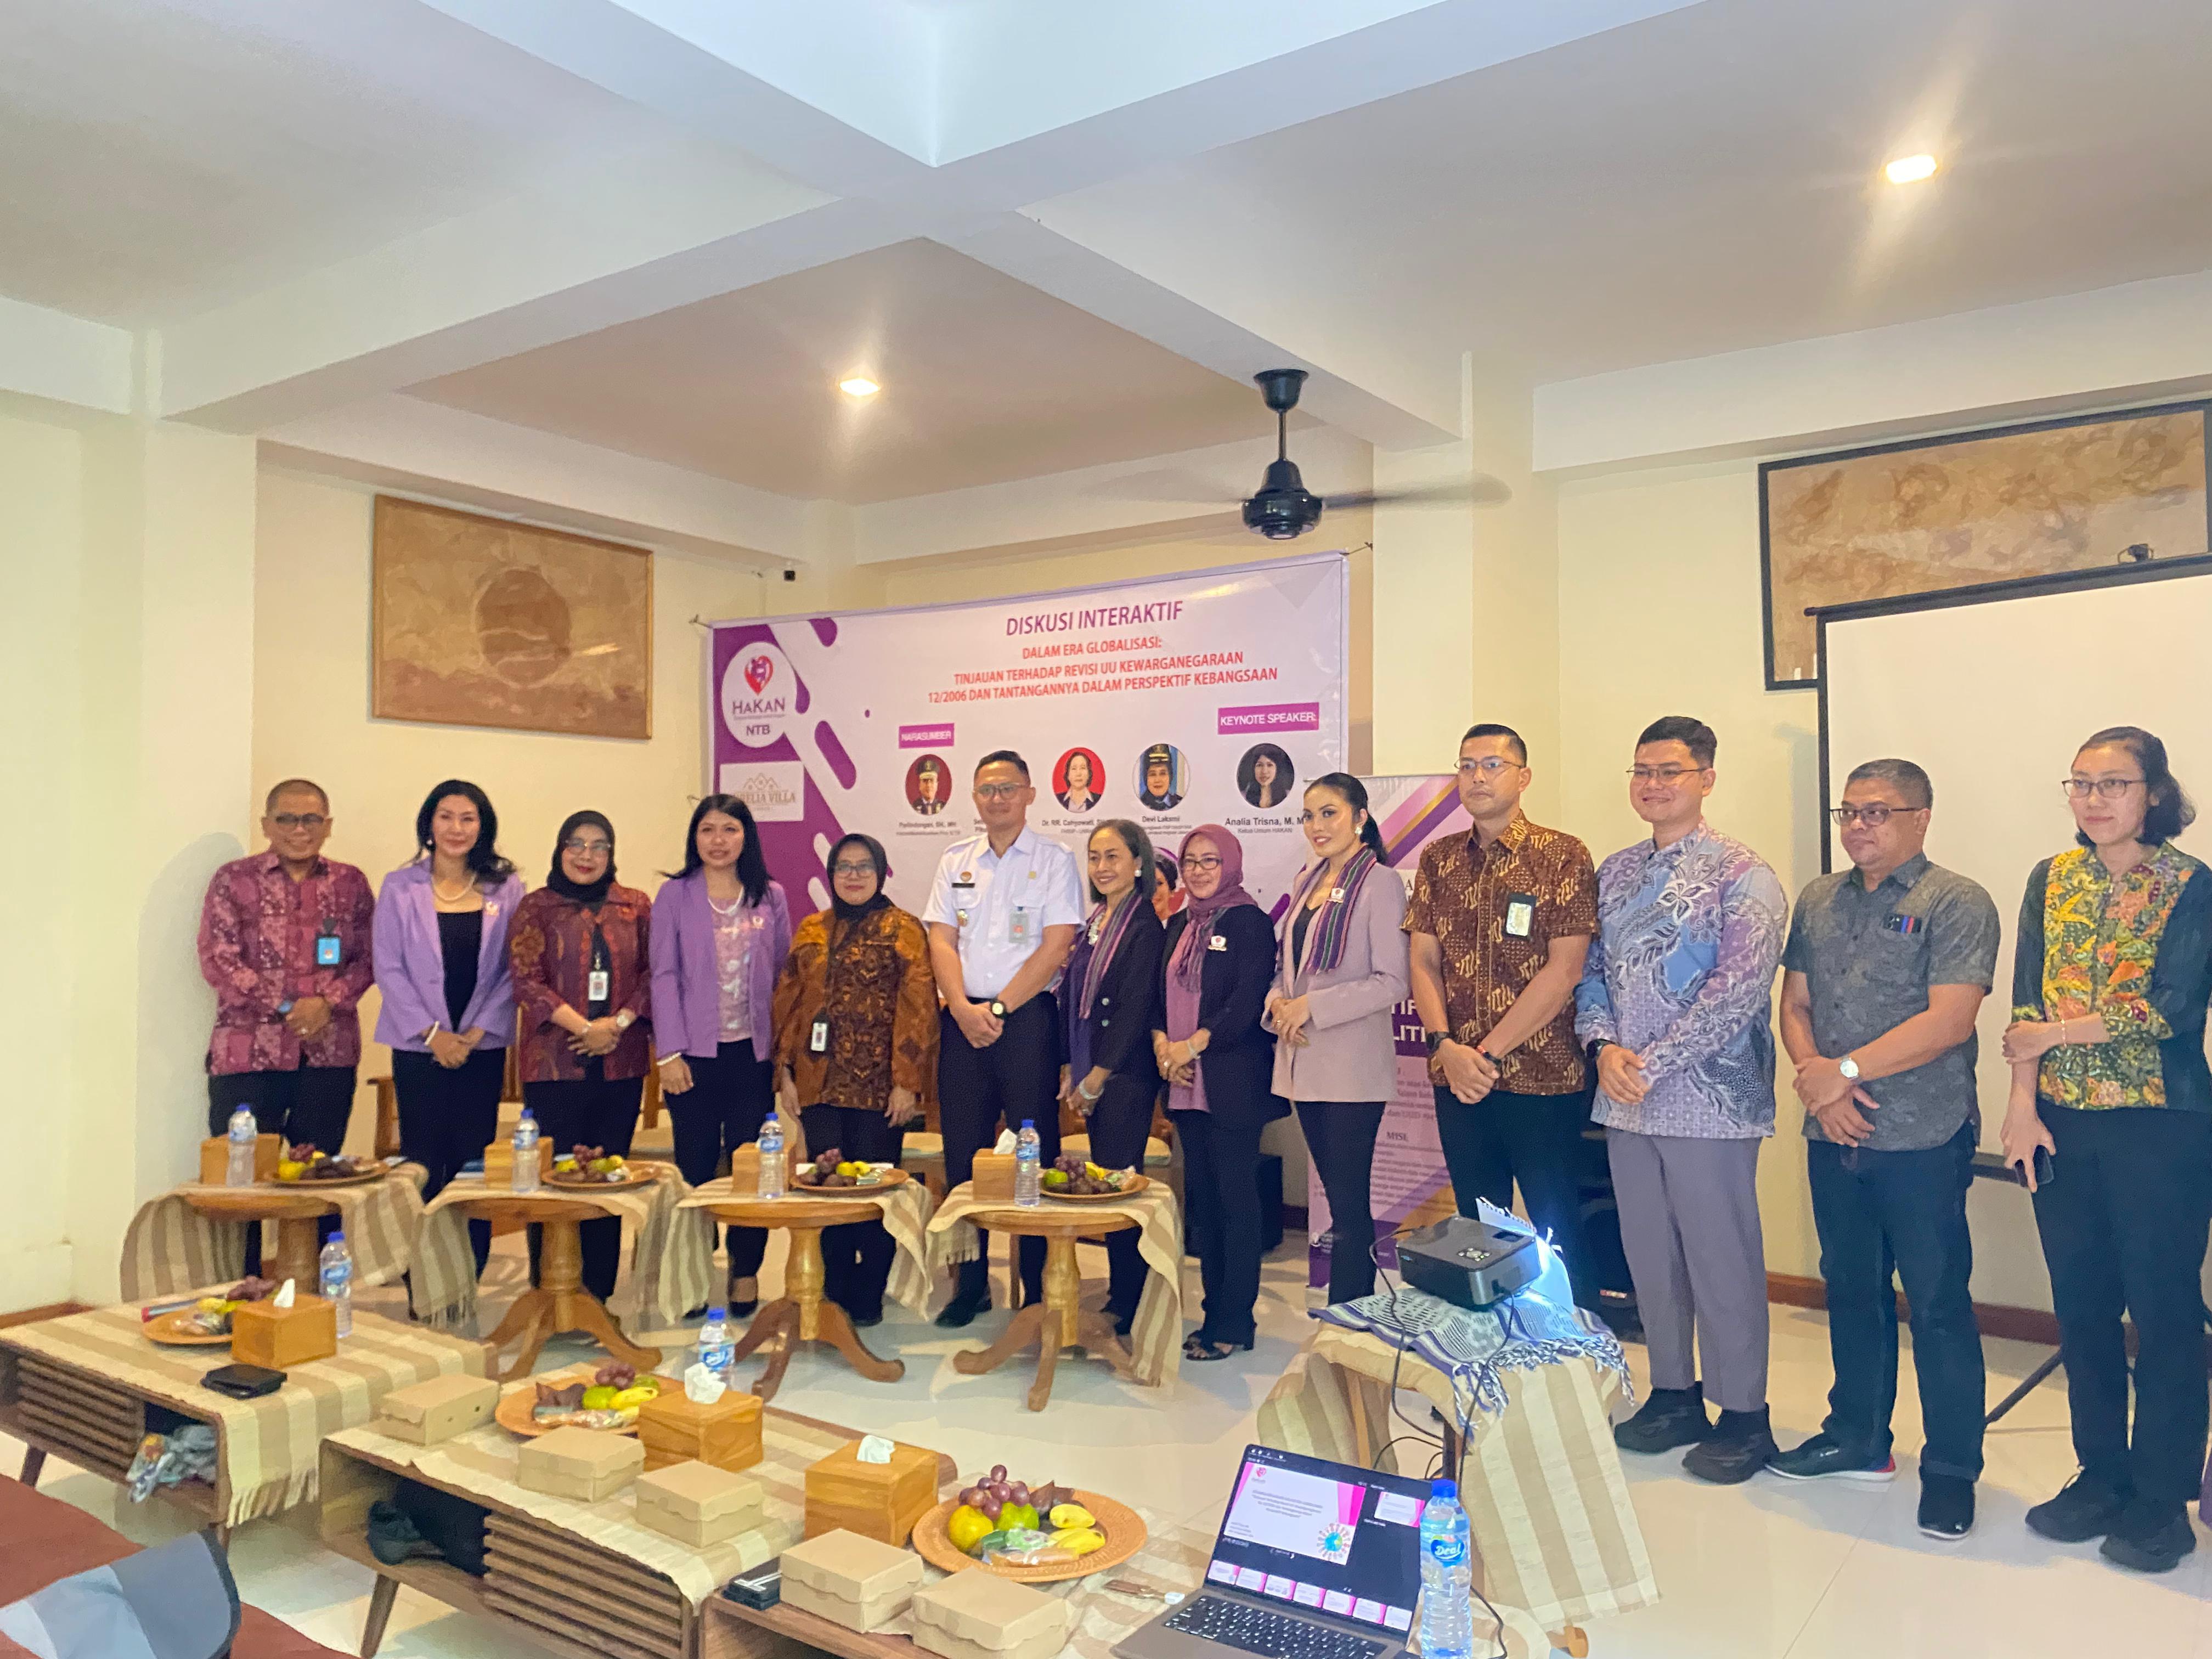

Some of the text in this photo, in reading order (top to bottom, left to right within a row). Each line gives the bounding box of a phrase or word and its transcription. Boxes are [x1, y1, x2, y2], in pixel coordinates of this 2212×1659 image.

[1006, 600, 1183, 636] DISKUSI INTERAKTIF
[1023, 636, 1162, 659] DALAM ERA GLOBALISASI:
[954, 651, 1244, 685] TINJAUAN TERHADAP REVISI UU KEWARGANEGARAAN
[928, 668, 1278, 703] 12/2006 DAN TANTANGANNYA DALAM PERSPEKTIF KEBANGSAAN
[747, 724, 771, 736] NTB
[1220, 713, 1265, 726] KEYNOTE
[1225, 817, 1251, 826] Analia
[1253, 817, 1282, 826] Trisna,
[1284, 817, 1294, 825] M.
